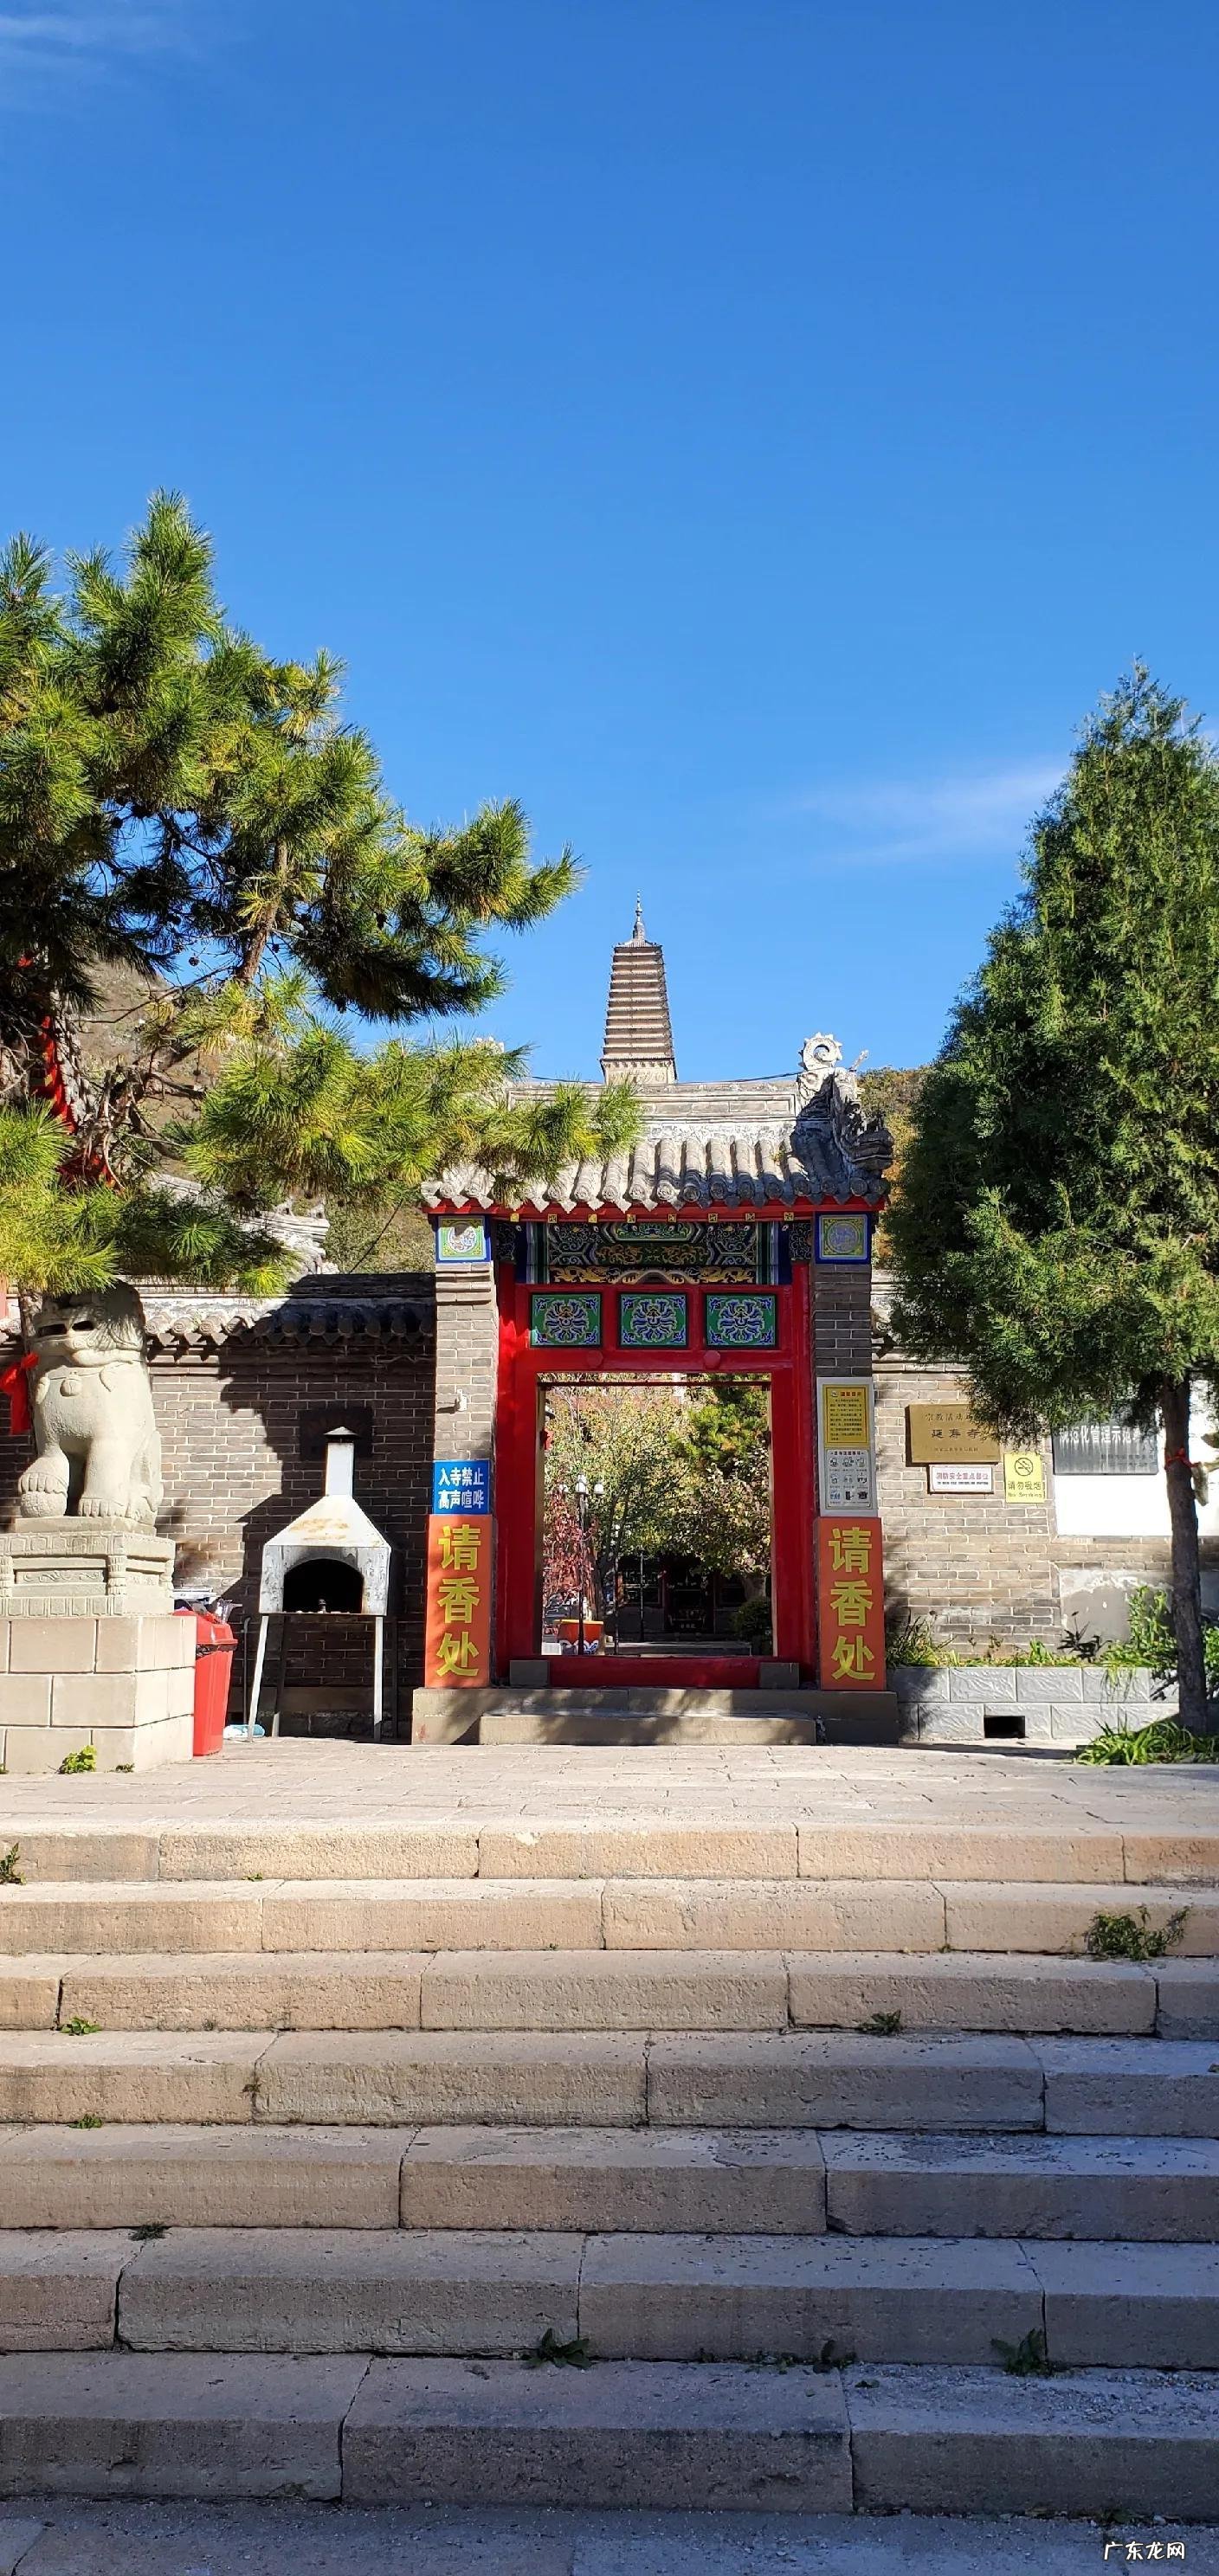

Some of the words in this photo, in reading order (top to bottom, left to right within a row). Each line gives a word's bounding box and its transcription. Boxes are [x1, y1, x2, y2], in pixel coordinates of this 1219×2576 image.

[438, 1467, 485, 1486] 入寺禁止
[1008, 1480, 1042, 1491] 请勿吸烟
[438, 1490, 485, 1510] 高声喧哗
[436, 1524, 481, 1677] 请香处
[829, 1527, 875, 1680] 请香处
